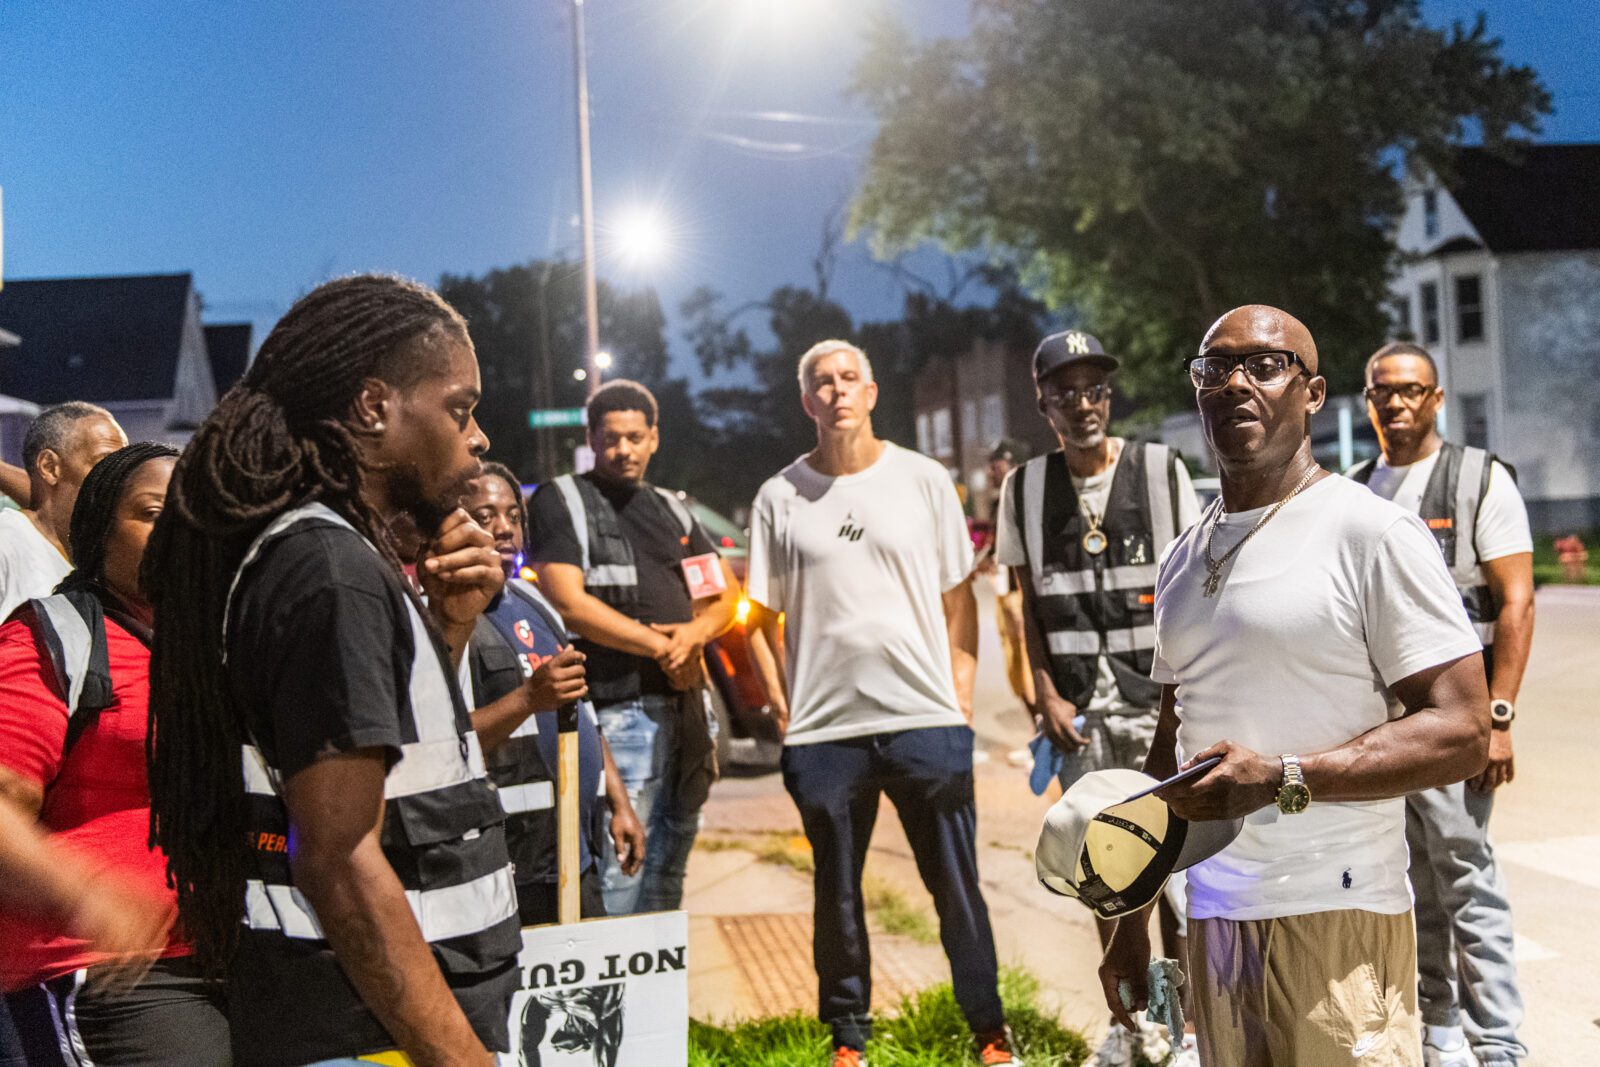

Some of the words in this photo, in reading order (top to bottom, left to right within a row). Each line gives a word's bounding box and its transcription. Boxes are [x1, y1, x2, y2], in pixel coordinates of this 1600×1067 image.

[1066, 332, 1089, 354] NY
[257, 831, 288, 853] PEA
[599, 946, 686, 981] NOT
